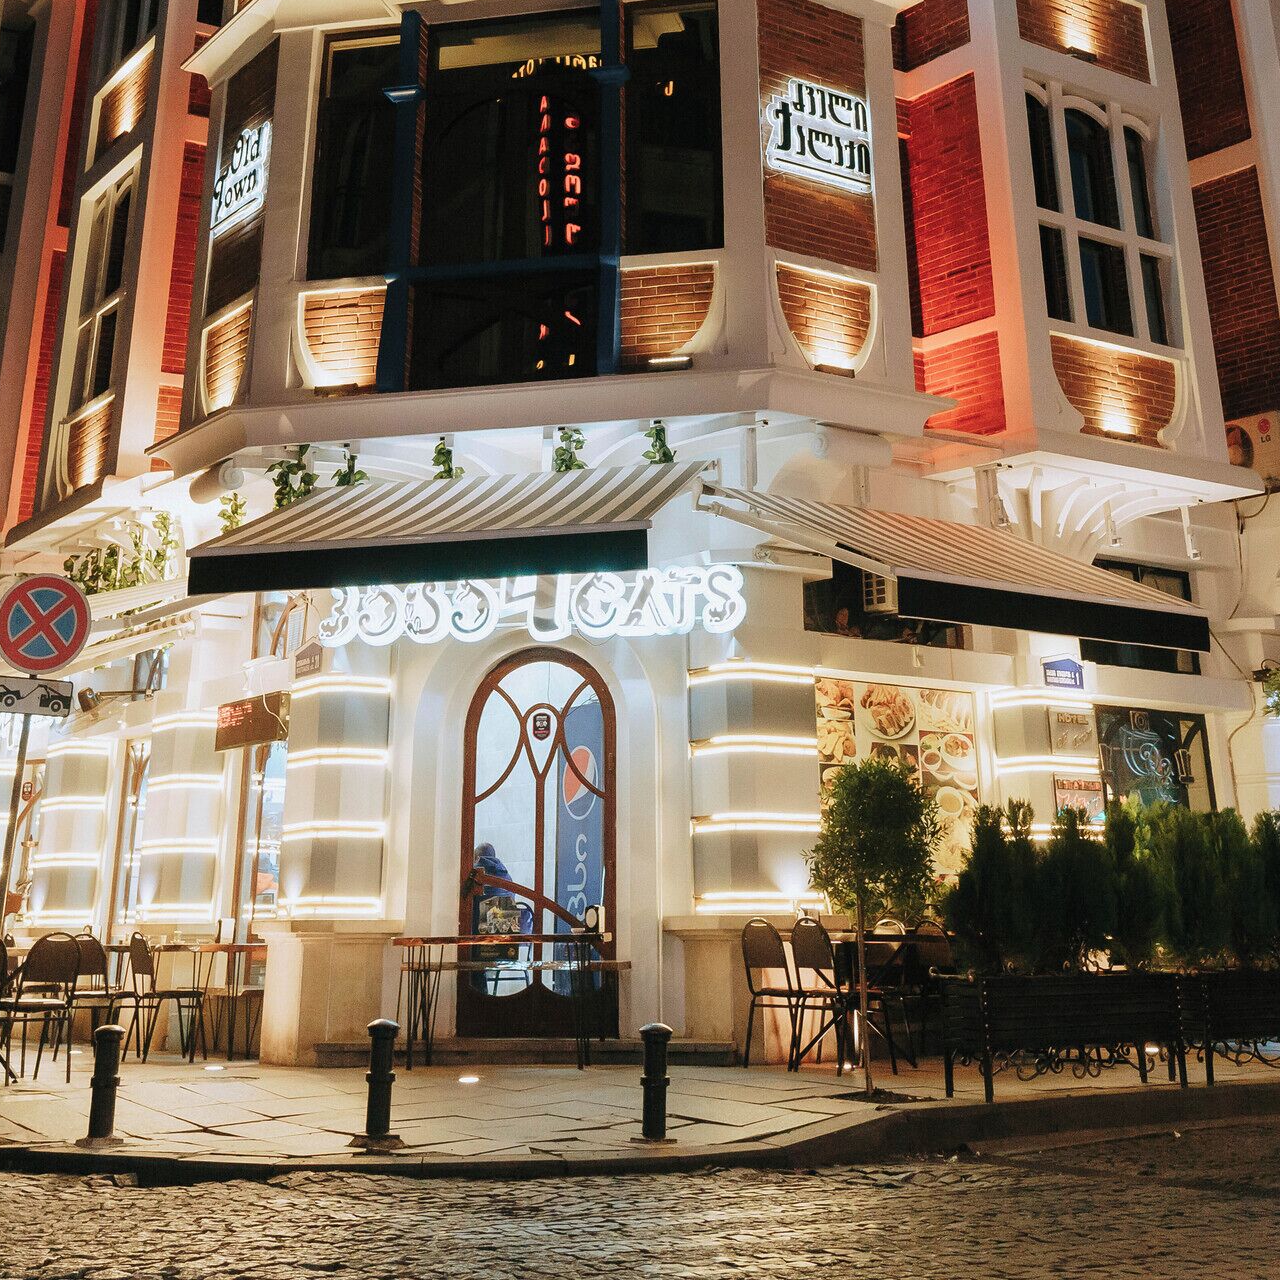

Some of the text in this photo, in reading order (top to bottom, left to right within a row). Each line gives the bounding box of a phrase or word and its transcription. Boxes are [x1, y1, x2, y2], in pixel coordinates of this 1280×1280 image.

[792, 83, 868, 132] ძველი
[231, 126, 264, 175] Old
[775, 101, 871, 175] ქალაქი
[214, 167, 257, 222] Town
[1260, 435, 1272, 443] LG
[573, 565, 746, 638] CATS
[1057, 712, 1089, 725] HOTEL
